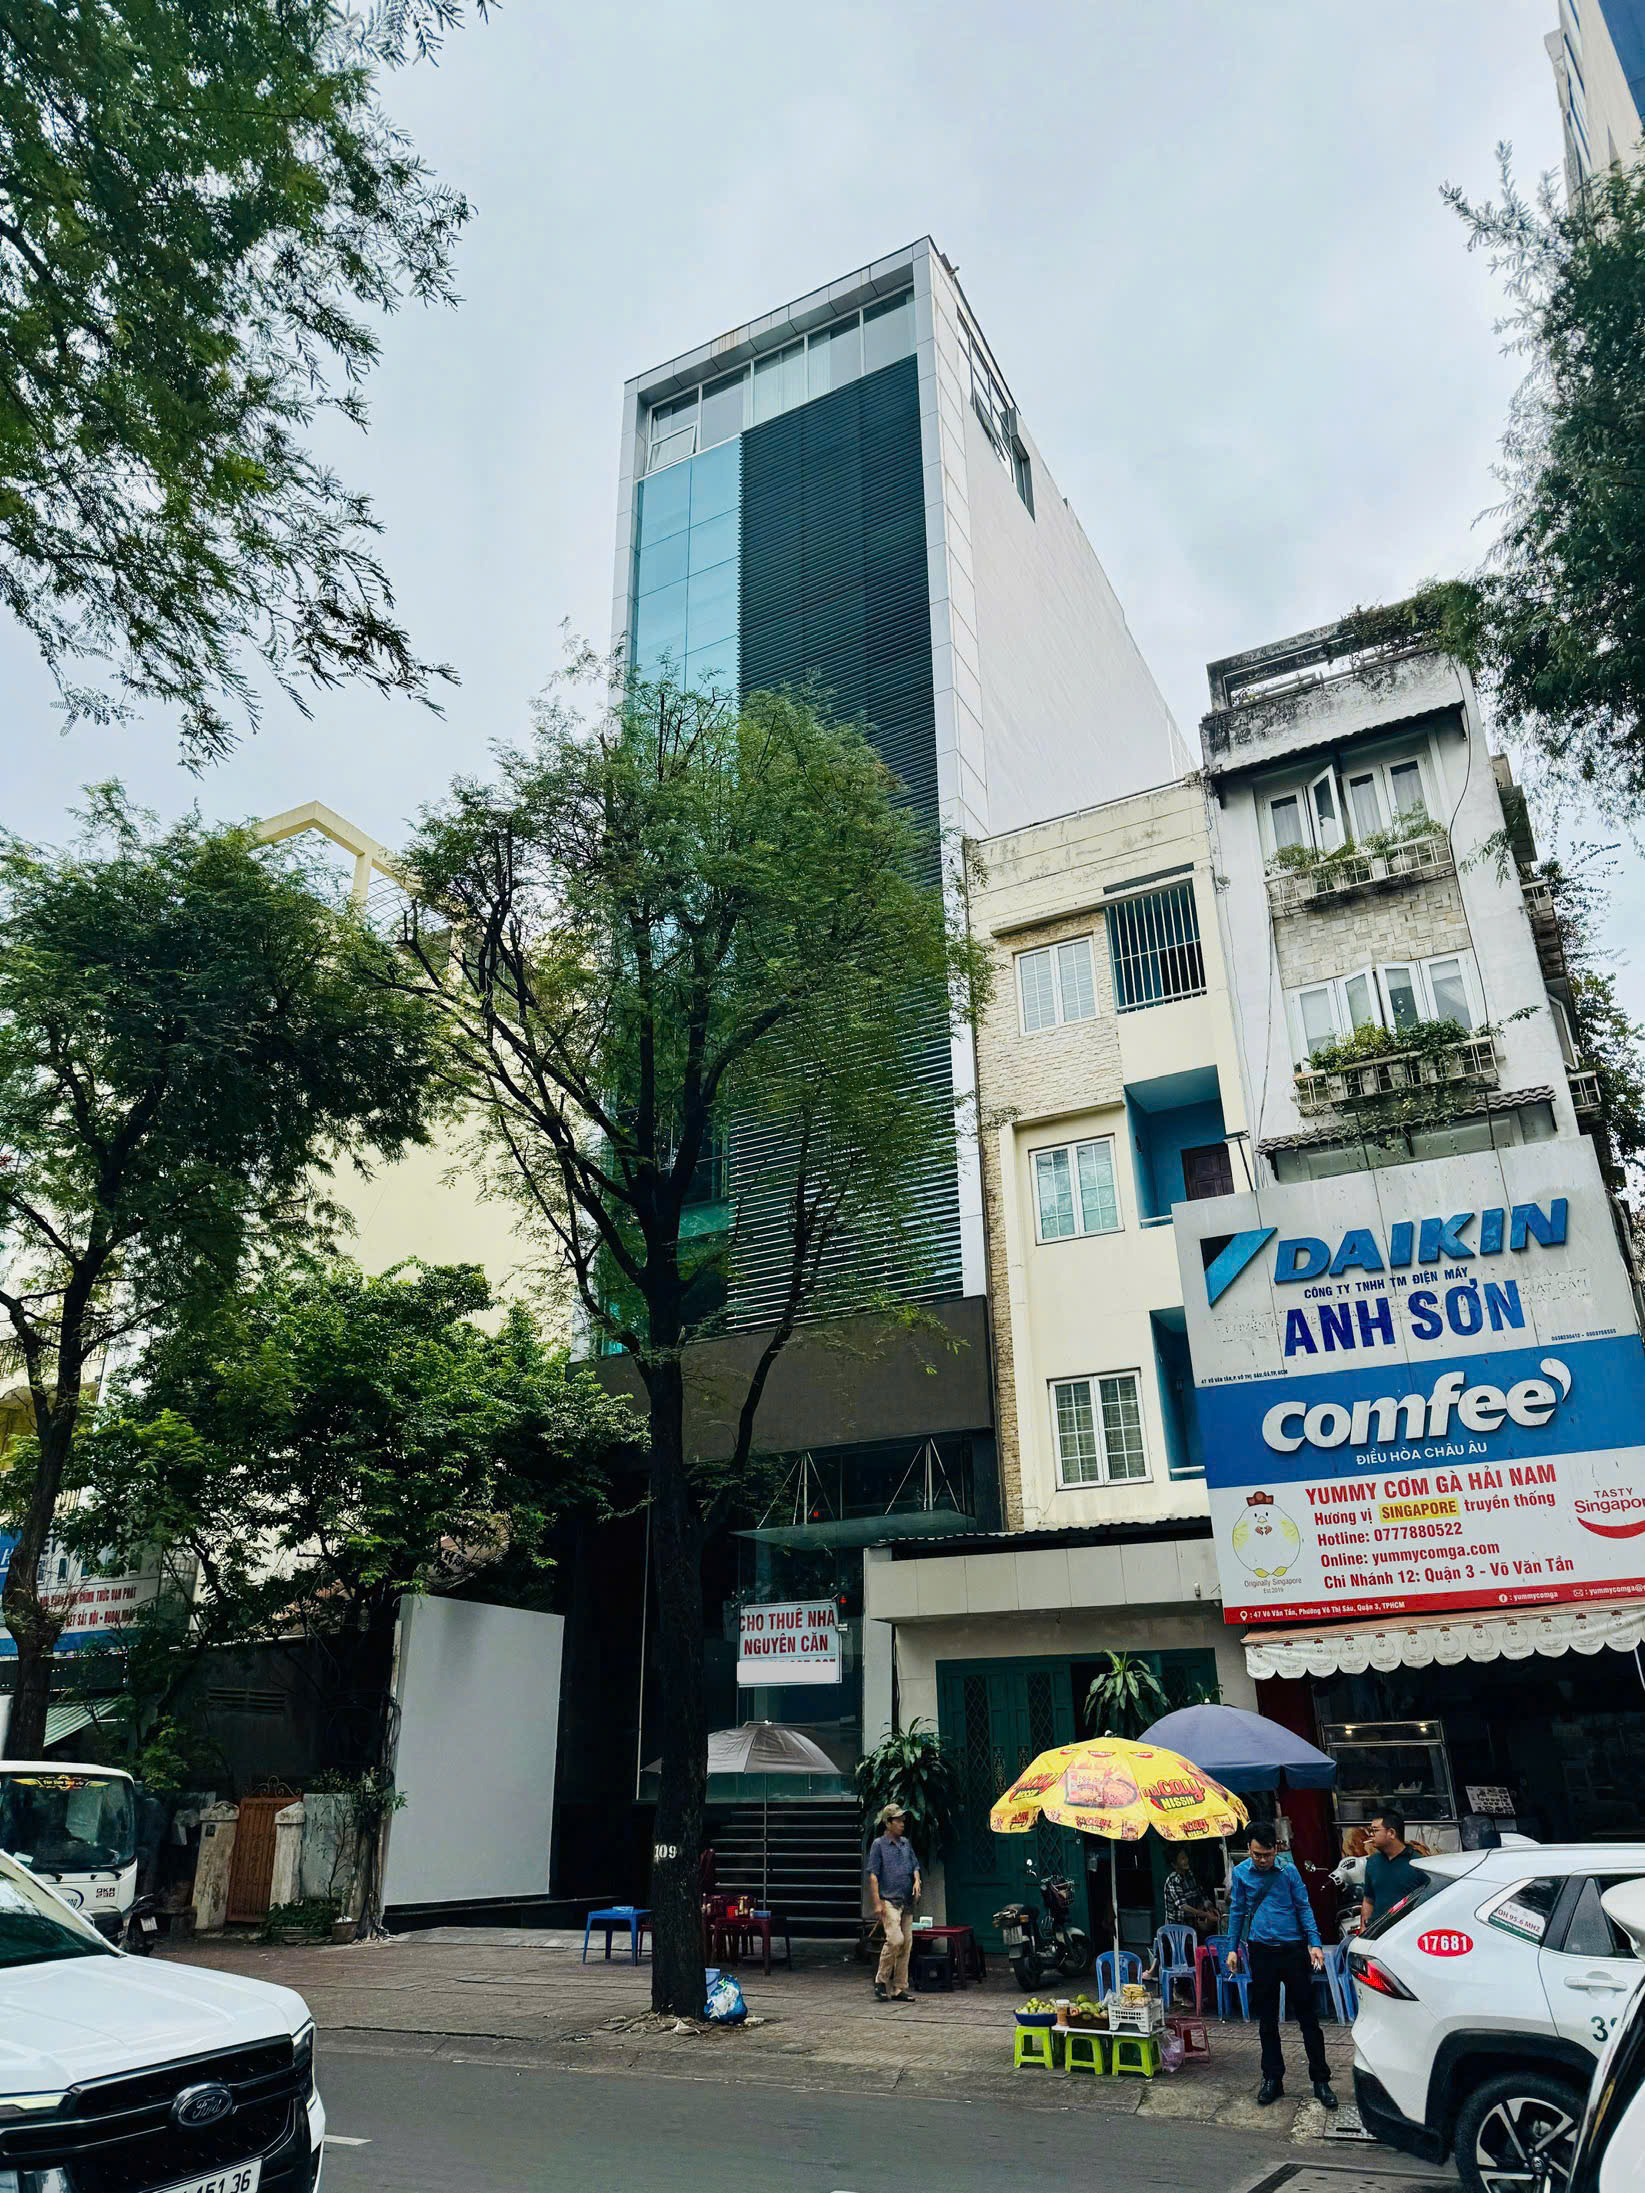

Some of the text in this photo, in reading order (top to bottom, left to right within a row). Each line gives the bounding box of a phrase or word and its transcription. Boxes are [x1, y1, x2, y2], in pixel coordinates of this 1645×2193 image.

[1274, 1198, 1568, 1285] DAIKIN
[1304, 1265, 1469, 1299] CÔNG TY TNHH TM ĐIỆN MÁY
[1284, 1278, 1526, 1358] ANH SƠN
[1356, 1439, 1488, 1466] ĐIỀU HÒA CHÂU ÂU
[1305, 1464, 1557, 1506] YUMMY CƠM GÀ HẢI NAM
[1593, 1487, 1633, 1499] TASTY
[1314, 1490, 1556, 1526] Hương vị SINGAPORE truyền thống
[1317, 1521, 1463, 1547] Hotline: 0777880522
[1320, 1543, 1500, 1568] Online: yummycomga.com
[1243, 1577, 1302, 1588] Originally Singapore
[1324, 1575, 1347, 1590] Chi
[1350, 1571, 1394, 1588] Nhánh
[1398, 1569, 1421, 1584] 12:
[1424, 1566, 1461, 1584] Quận
[1465, 1564, 1475, 1579] 3
[1489, 1560, 1509, 1577] Võ
[1512, 1559, 1542, 1575] Văn
[1545, 1554, 1575, 1573] Tần
[1382, 1600, 1406, 1610] TPHCM
[1513, 1591, 1559, 1602] yummycomga
[740, 1605, 836, 1632] CHO THUÊ NHÀ
[743, 1631, 829, 1656] NGUYÊN CĂN
[1160, 1795, 1196, 1810] NISSIN
[654, 1844, 678, 1859] 109
[1422, 1934, 1469, 1951] 17681
[230, 2168, 252, 2193] 36
